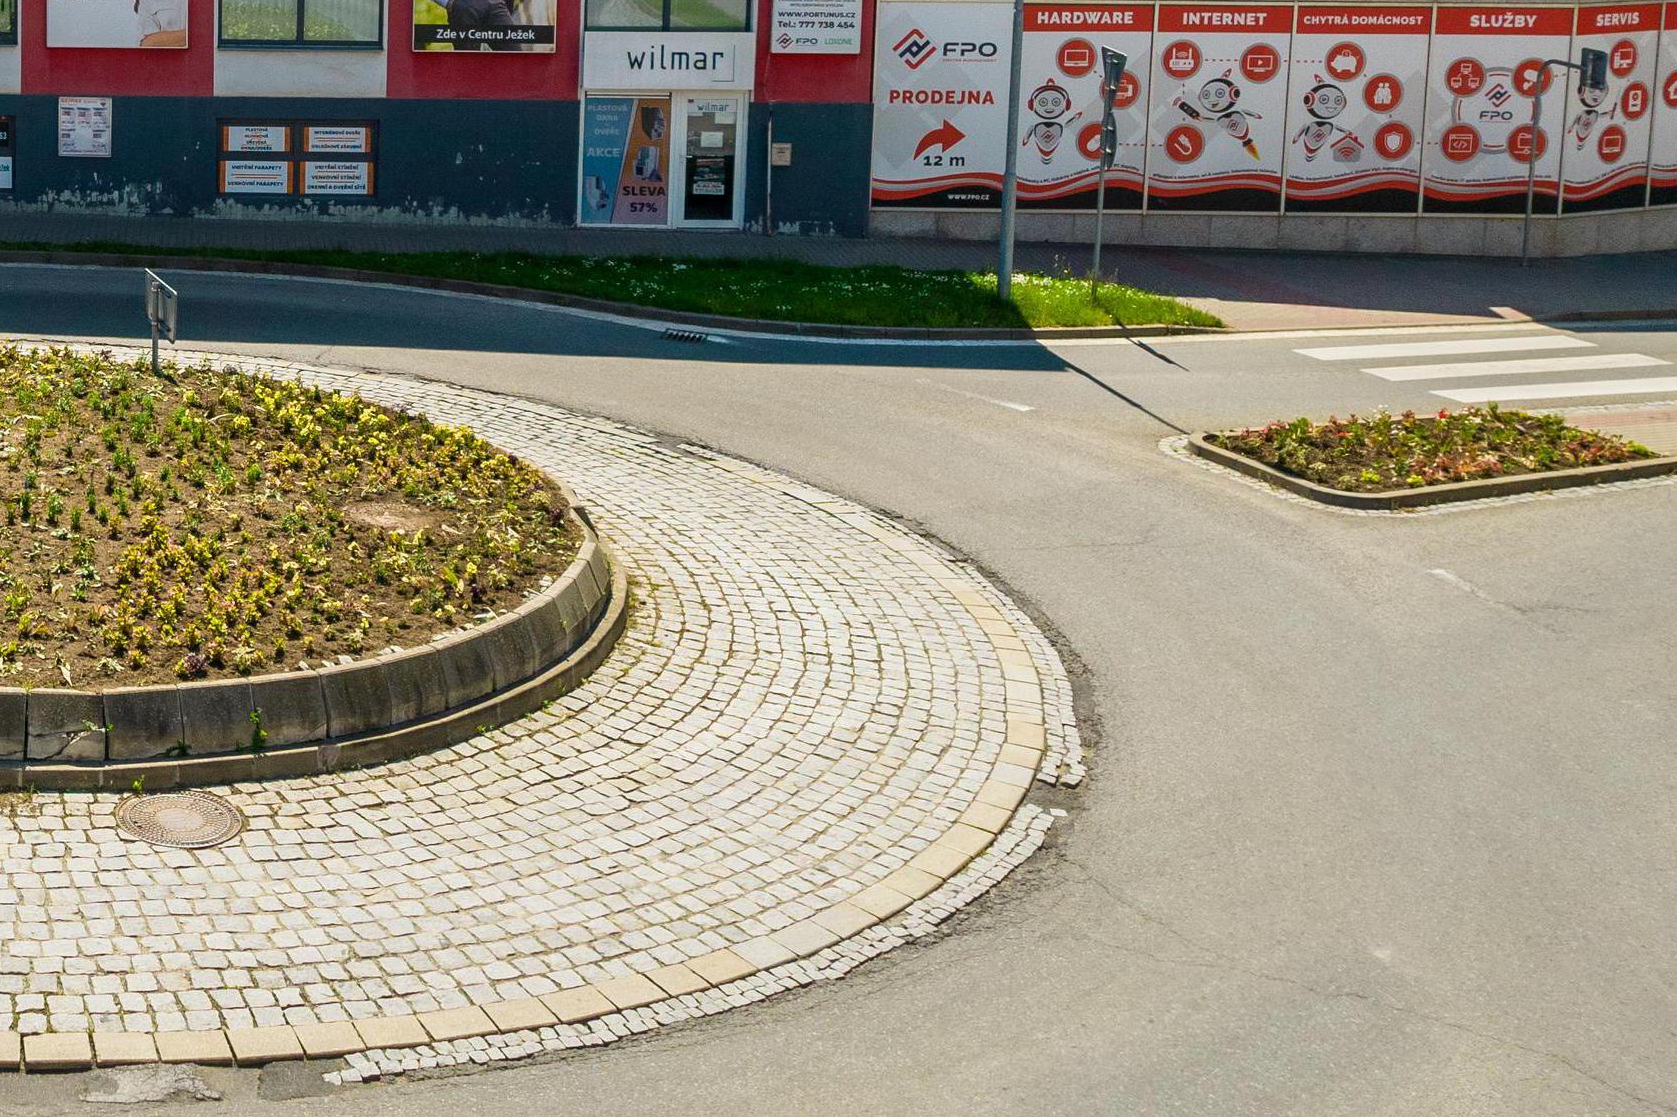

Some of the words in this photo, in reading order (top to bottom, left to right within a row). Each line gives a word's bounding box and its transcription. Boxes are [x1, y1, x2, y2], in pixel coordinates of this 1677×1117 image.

[1037, 11, 1134, 24] HARDWARE
[1182, 12, 1267, 25] INTERNET
[1303, 13, 1349, 25] CHYTRÁ
[1351, 13, 1424, 25] DOMÁCNOST
[1470, 11, 1537, 27] SLUŽBY
[1595, 12, 1640, 26] SERVIS
[436, 29, 457, 39] Zde
[468, 29, 503, 40] Centru
[506, 29, 535, 40] Ježek
[943, 43, 997, 57] FPO
[627, 44, 724, 70] wilmar
[889, 90, 995, 105] PRODEJNA
[698, 103, 729, 112] wilmar
[1480, 111, 1513, 120] FPO
[587, 147, 620, 157] AKCE
[923, 155, 942, 166] 12
[949, 156, 965, 166] m
[623, 186, 666, 196] SLEVA
[630, 202, 657, 213] 57%
